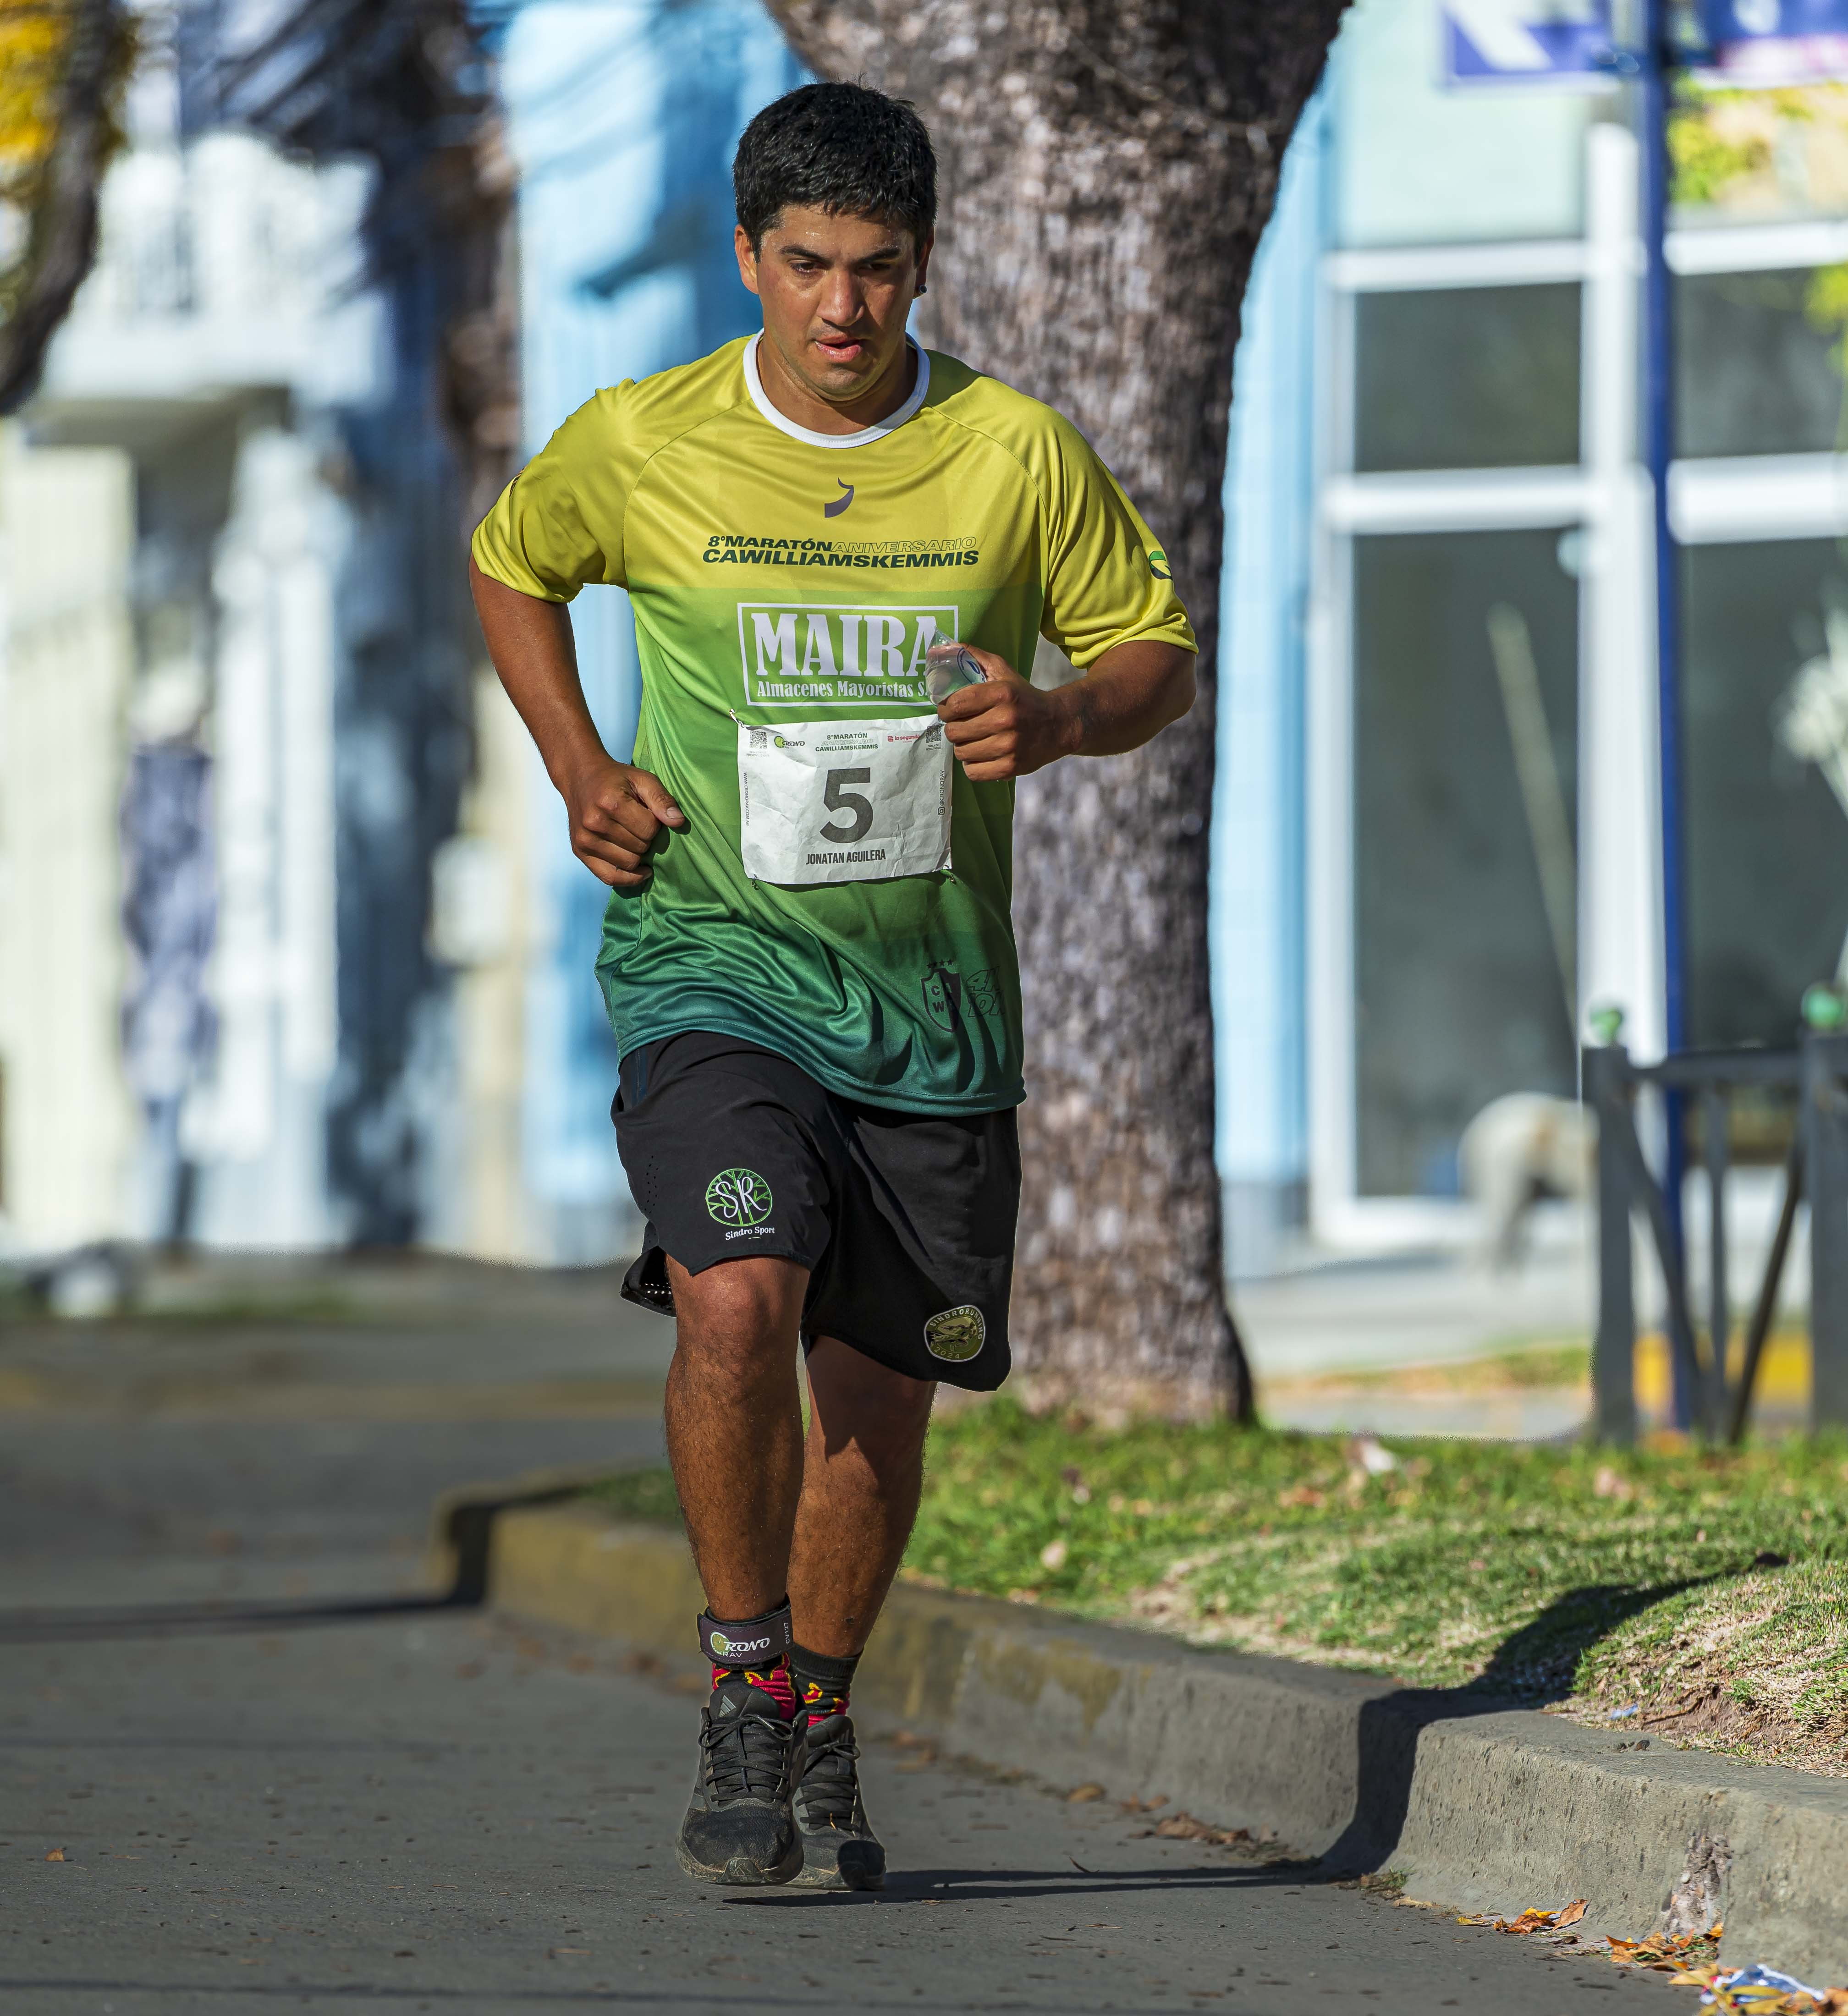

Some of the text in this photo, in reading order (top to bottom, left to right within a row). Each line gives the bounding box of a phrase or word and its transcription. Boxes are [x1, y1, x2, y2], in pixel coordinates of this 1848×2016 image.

[830, 536, 976, 554] ANIVERSARIO
[703, 549, 979, 568] CAWILLIAMSKEMMIS
[751, 613, 936, 676] MAIRA
[757, 681, 833, 697] Almacenes
[837, 681, 913, 698] Mayoristas
[815, 744, 879, 752] CAWILLIAMSKEMMIS
[820, 767, 874, 844] 5
[806, 849, 886, 865] JONATAN AGUILERA
[725, 1226, 775, 1240] Sindro Sport
[934, 1347, 960, 1359] 2024
